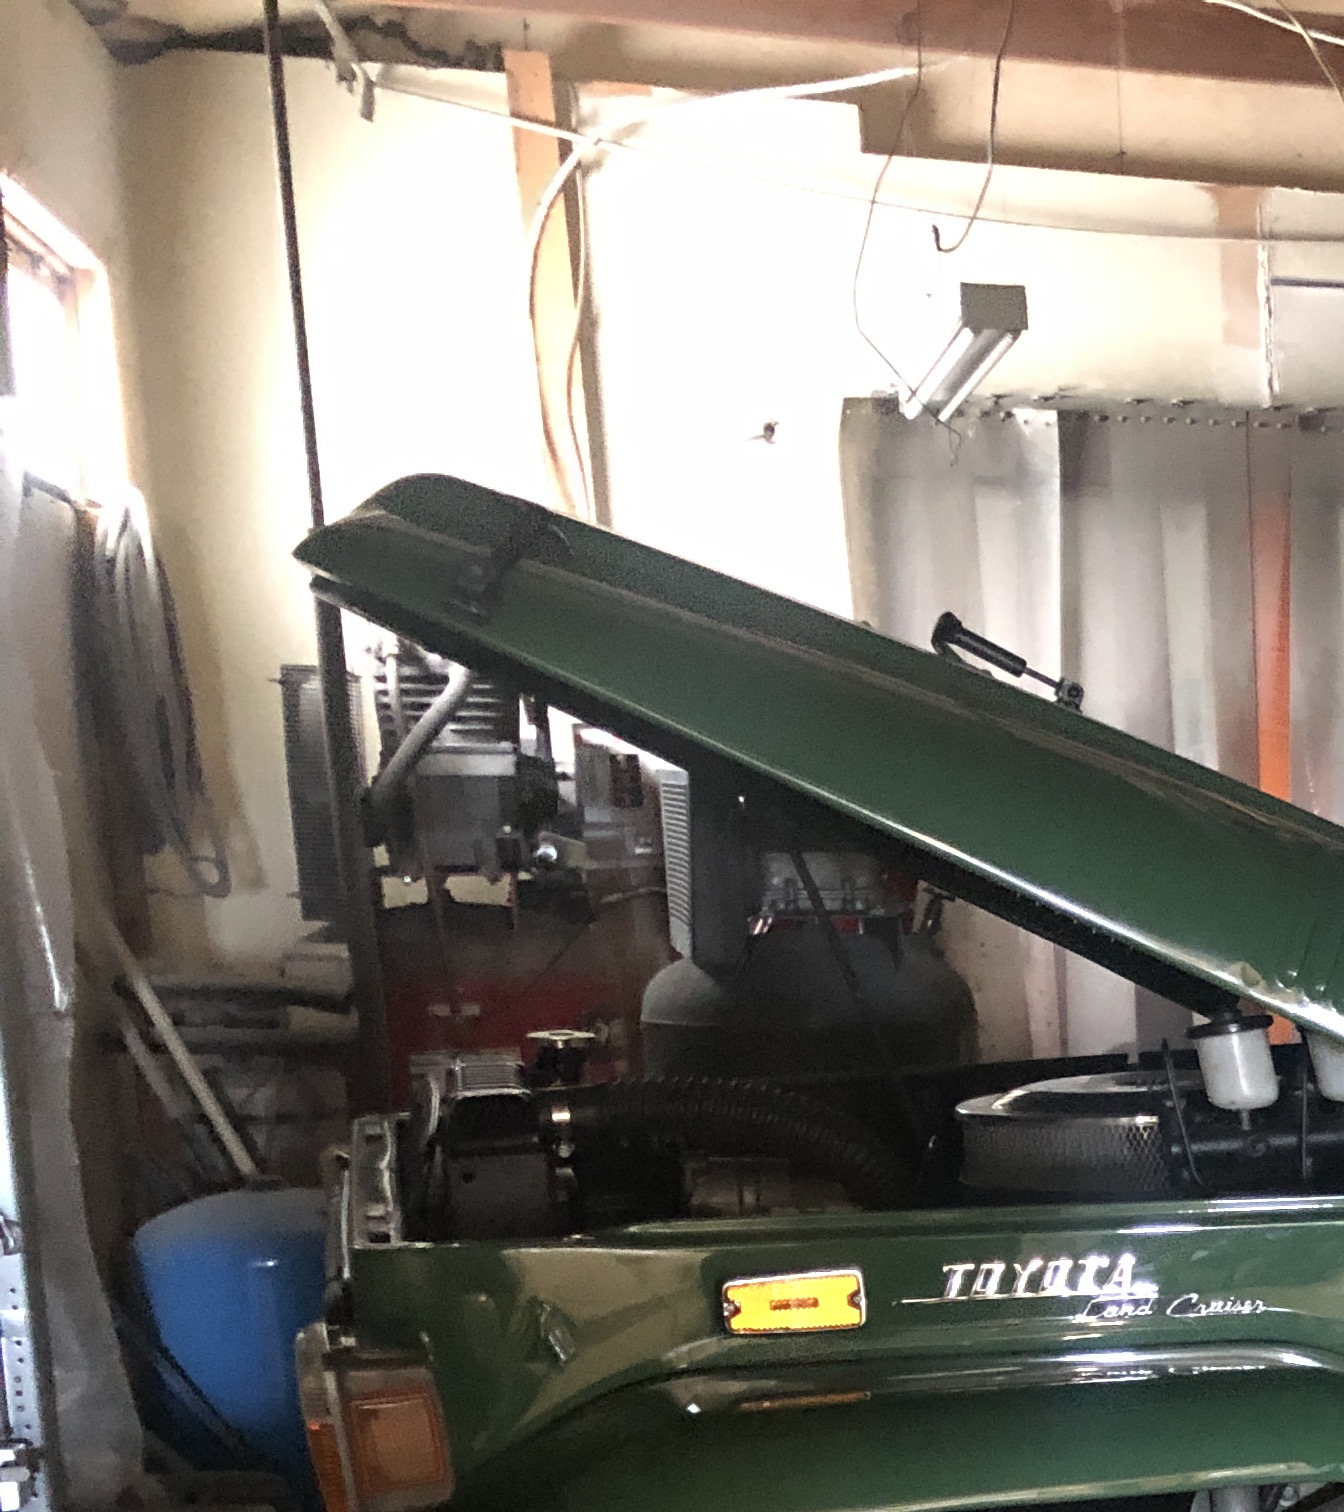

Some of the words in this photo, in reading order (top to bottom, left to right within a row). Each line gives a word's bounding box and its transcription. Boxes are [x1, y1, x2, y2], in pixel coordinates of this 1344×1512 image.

[942, 1253, 1137, 1298] TOYOTA
[1075, 1297, 1154, 1321] Land
[1166, 1293, 1267, 1318] Cruiser
